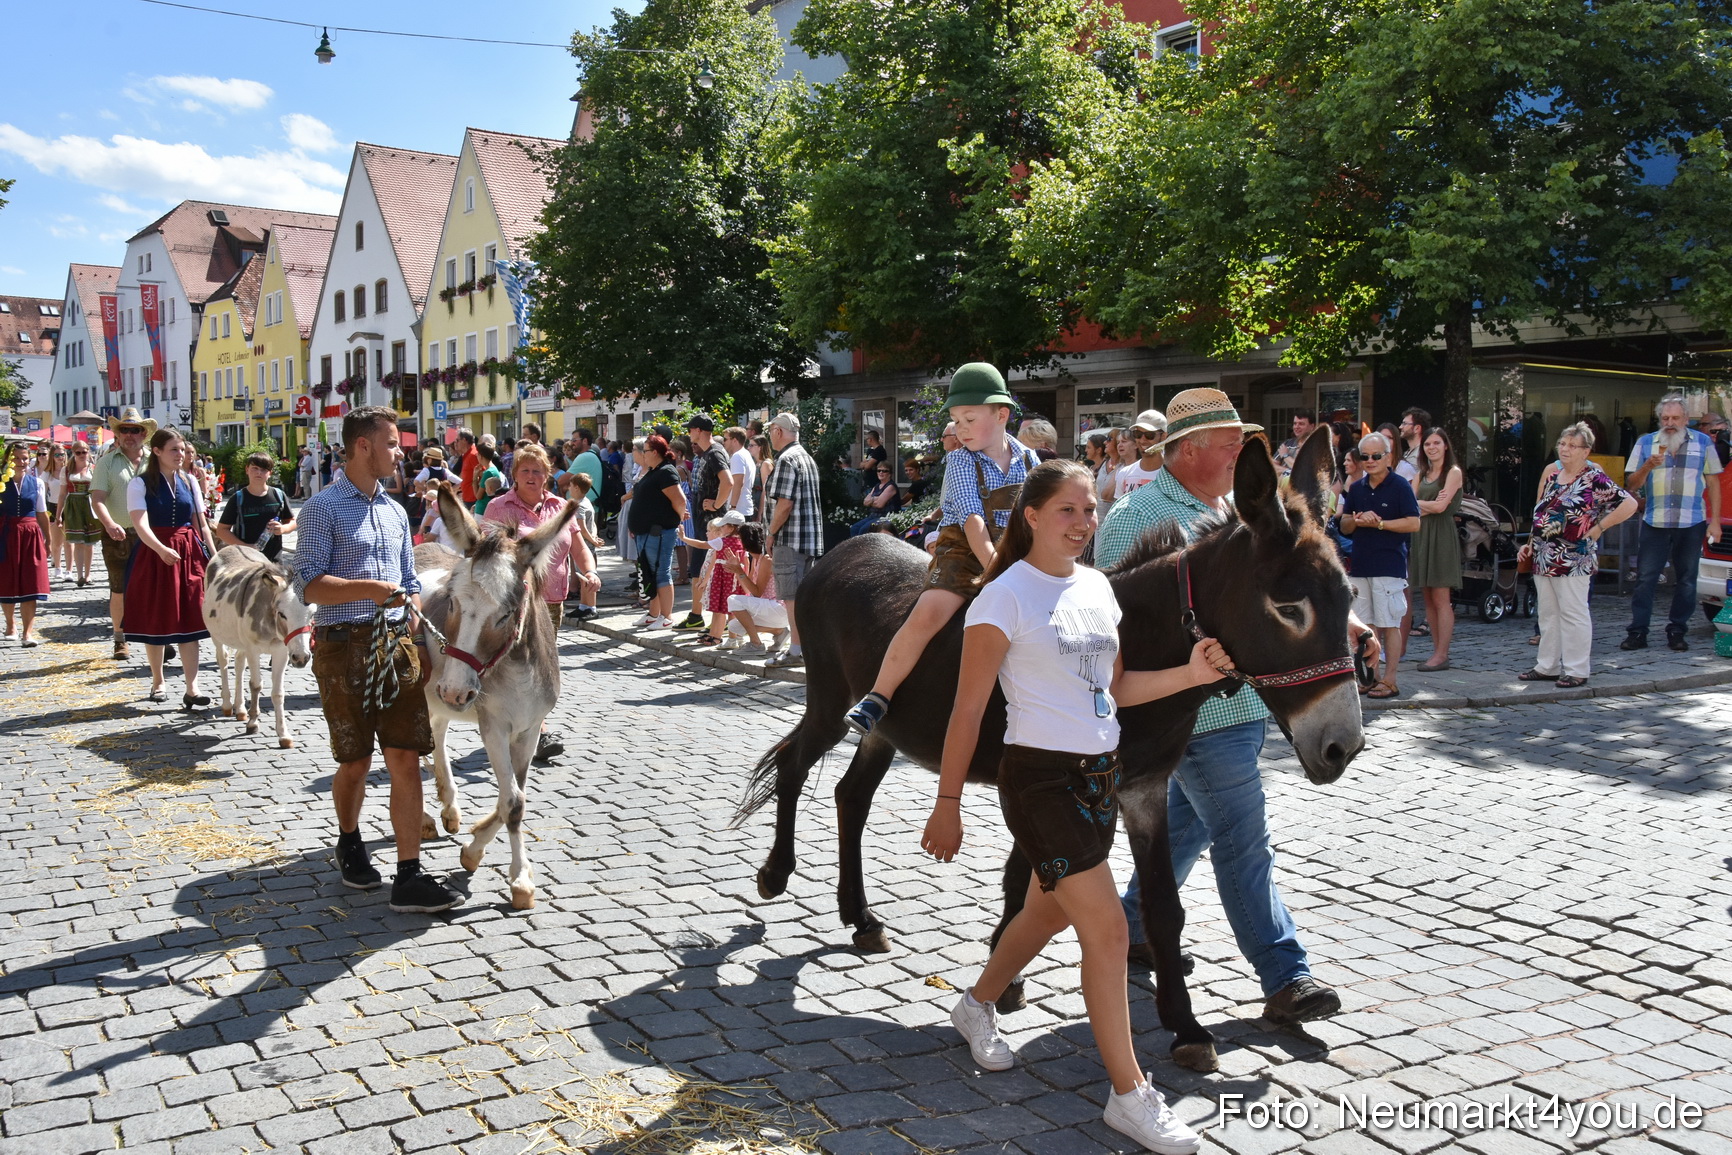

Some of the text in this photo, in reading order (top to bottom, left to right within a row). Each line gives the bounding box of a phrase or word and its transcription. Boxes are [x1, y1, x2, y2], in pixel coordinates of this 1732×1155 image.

[217, 352, 232, 365] HOTEL
[436, 403, 445, 419] P
[1057, 635, 1118, 655] hat heute
